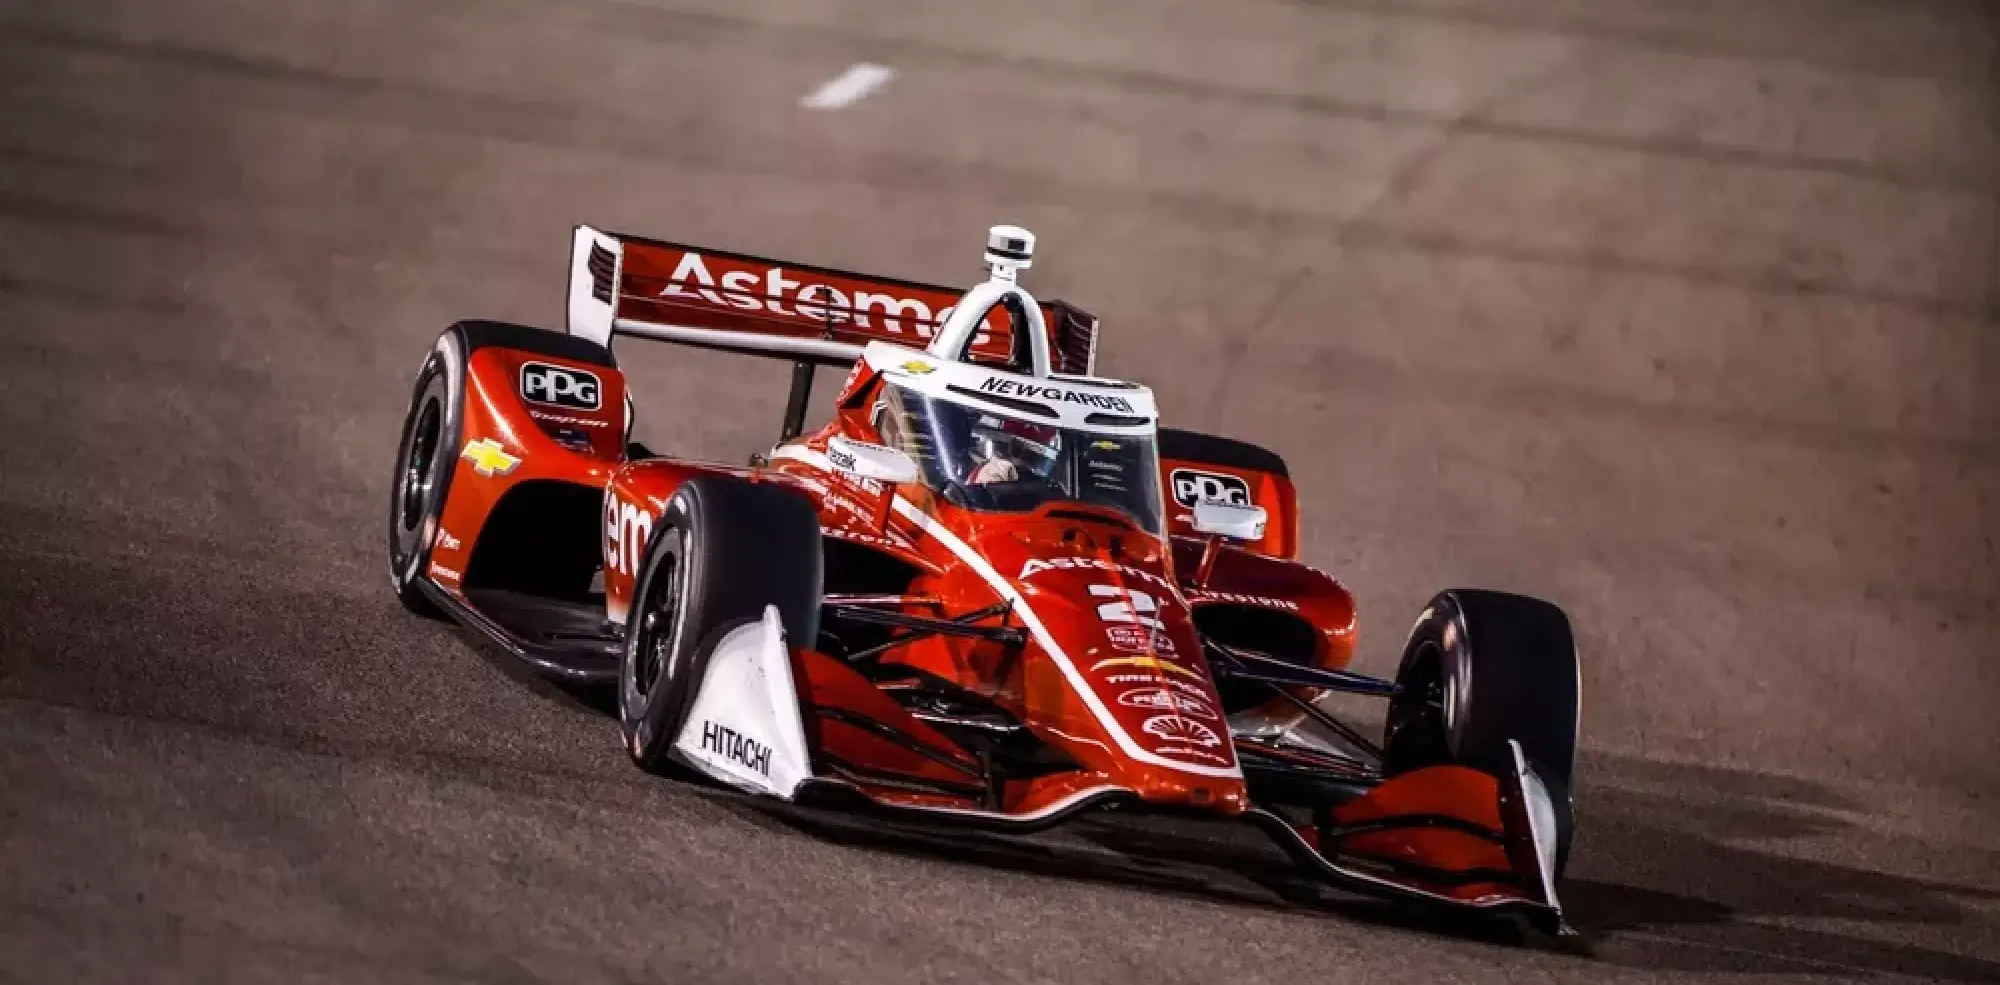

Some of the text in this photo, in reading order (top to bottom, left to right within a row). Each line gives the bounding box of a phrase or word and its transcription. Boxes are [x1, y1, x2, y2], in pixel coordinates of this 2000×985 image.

[525, 370, 597, 404] PPG
[979, 377, 1134, 413] NEWGARDEN
[1088, 584, 1166, 631] 2
[702, 720, 773, 778] HITACHI
